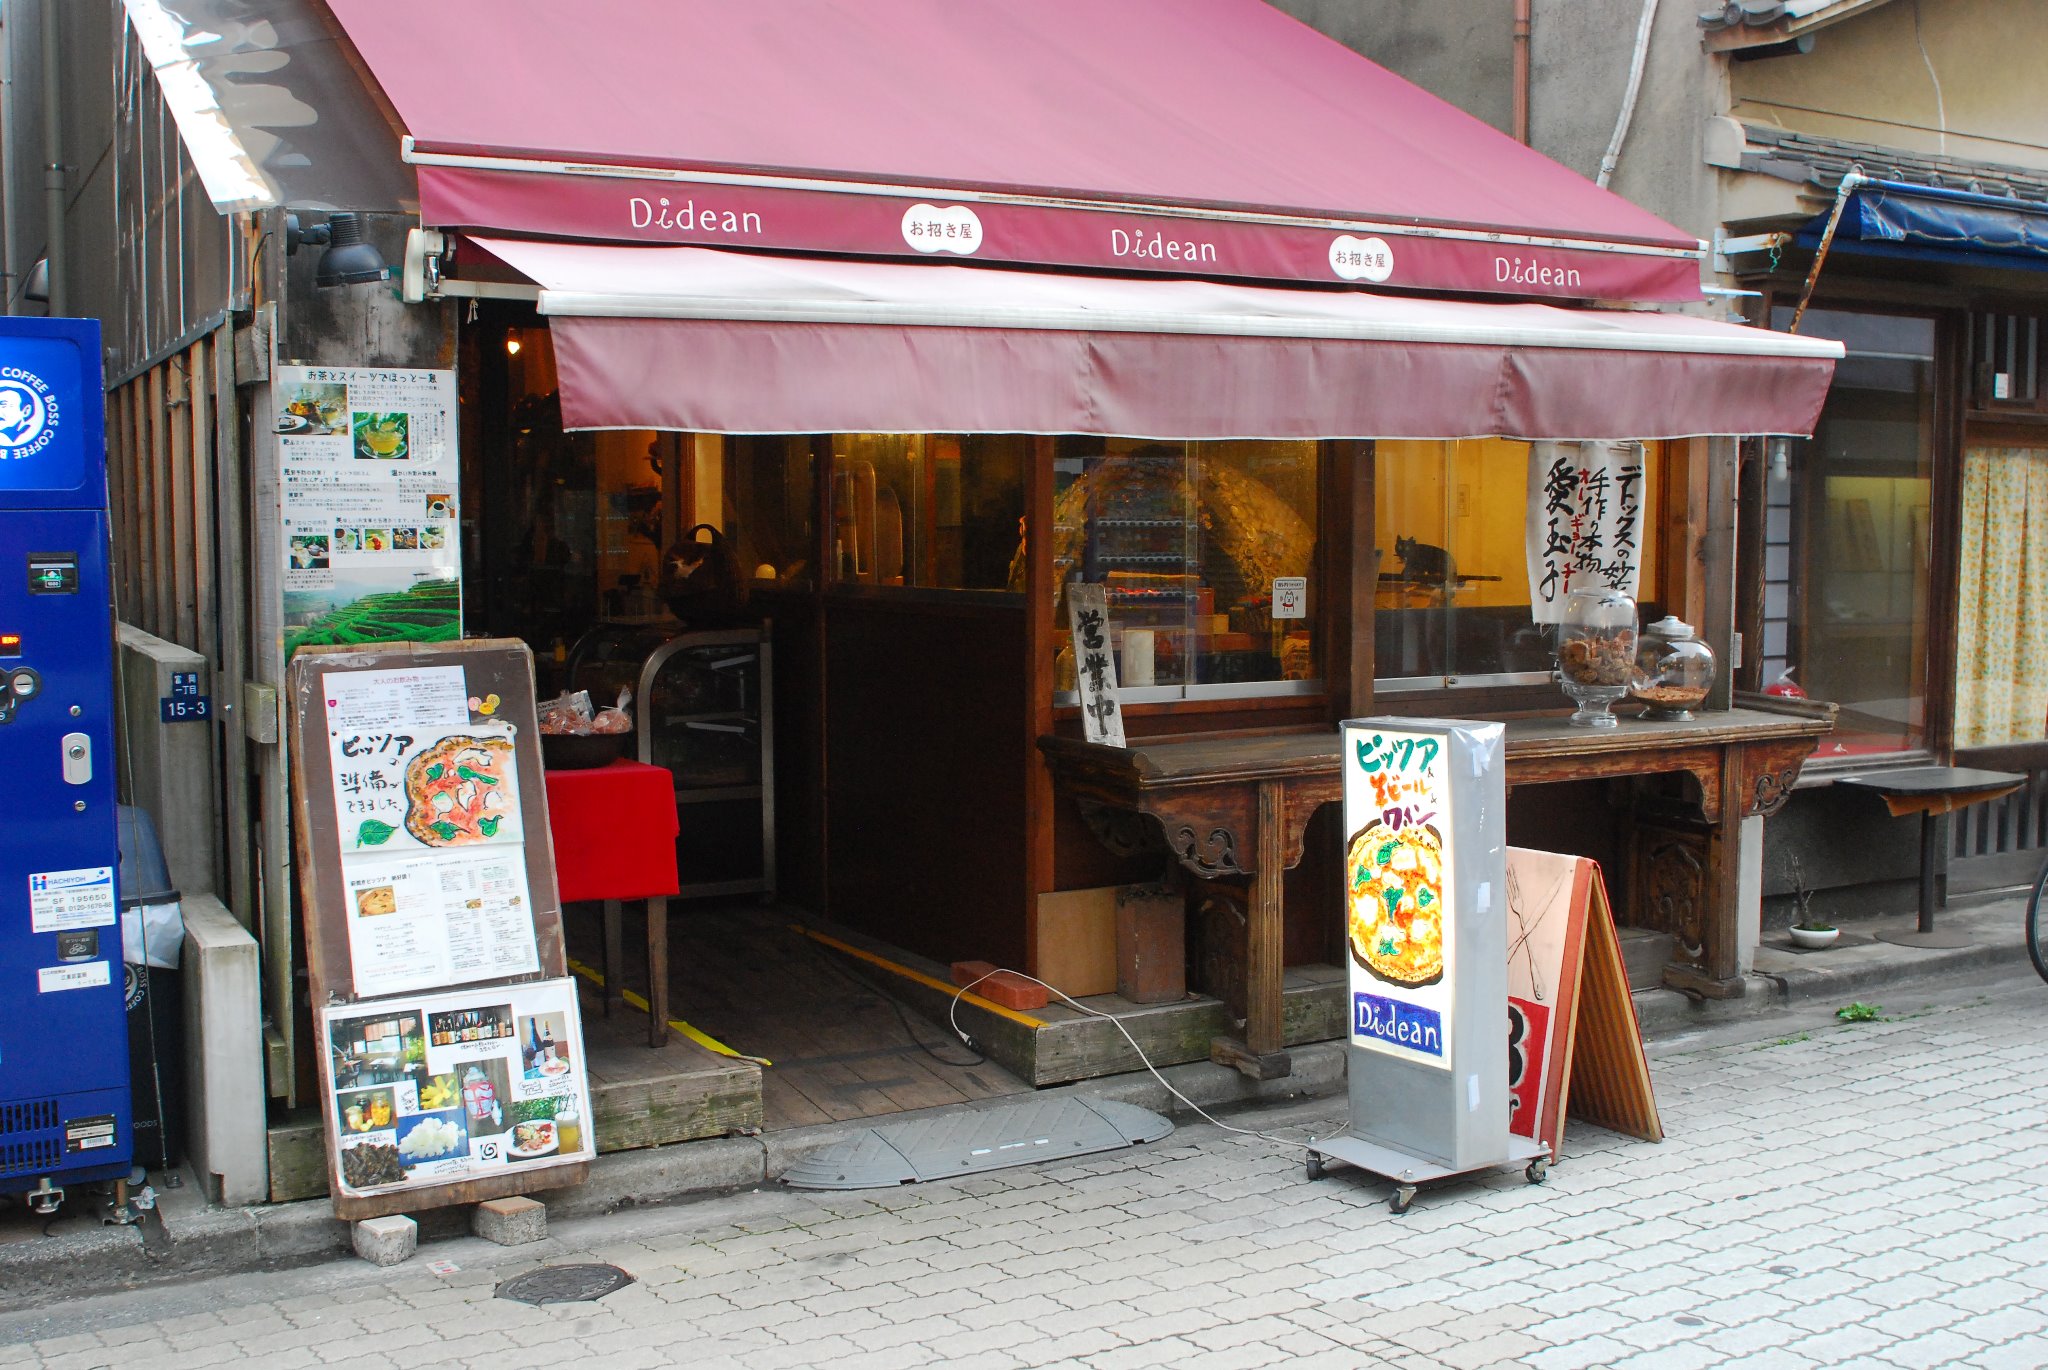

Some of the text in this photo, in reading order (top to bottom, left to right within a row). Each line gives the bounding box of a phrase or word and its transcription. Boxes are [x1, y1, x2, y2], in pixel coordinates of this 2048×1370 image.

[630, 197, 762, 234] Didean
[910, 220, 973, 239] お招き屋
[1111, 229, 1217, 262] Didean
[1335, 250, 1385, 268] お招き屋
[1495, 257, 1581, 287] Didean
[307, 371, 438, 384] お茶とスイーツでほっと一息
[2, 366, 60, 460] COFFEE BOSS COFFEE
[1539, 457, 1579, 602] 愛玉子
[1561, 468, 1590, 593] オーギョーチー
[1574, 467, 1611, 574] 手作り本物
[1077, 608, 1116, 737] 営業中
[168, 701, 206, 716] 15-3
[1370, 772, 1432, 809] 生ビール
[1383, 804, 1438, 831] ワイン
[136, 966, 148, 988] BOSS
[1358, 1001, 1440, 1050] Didean
